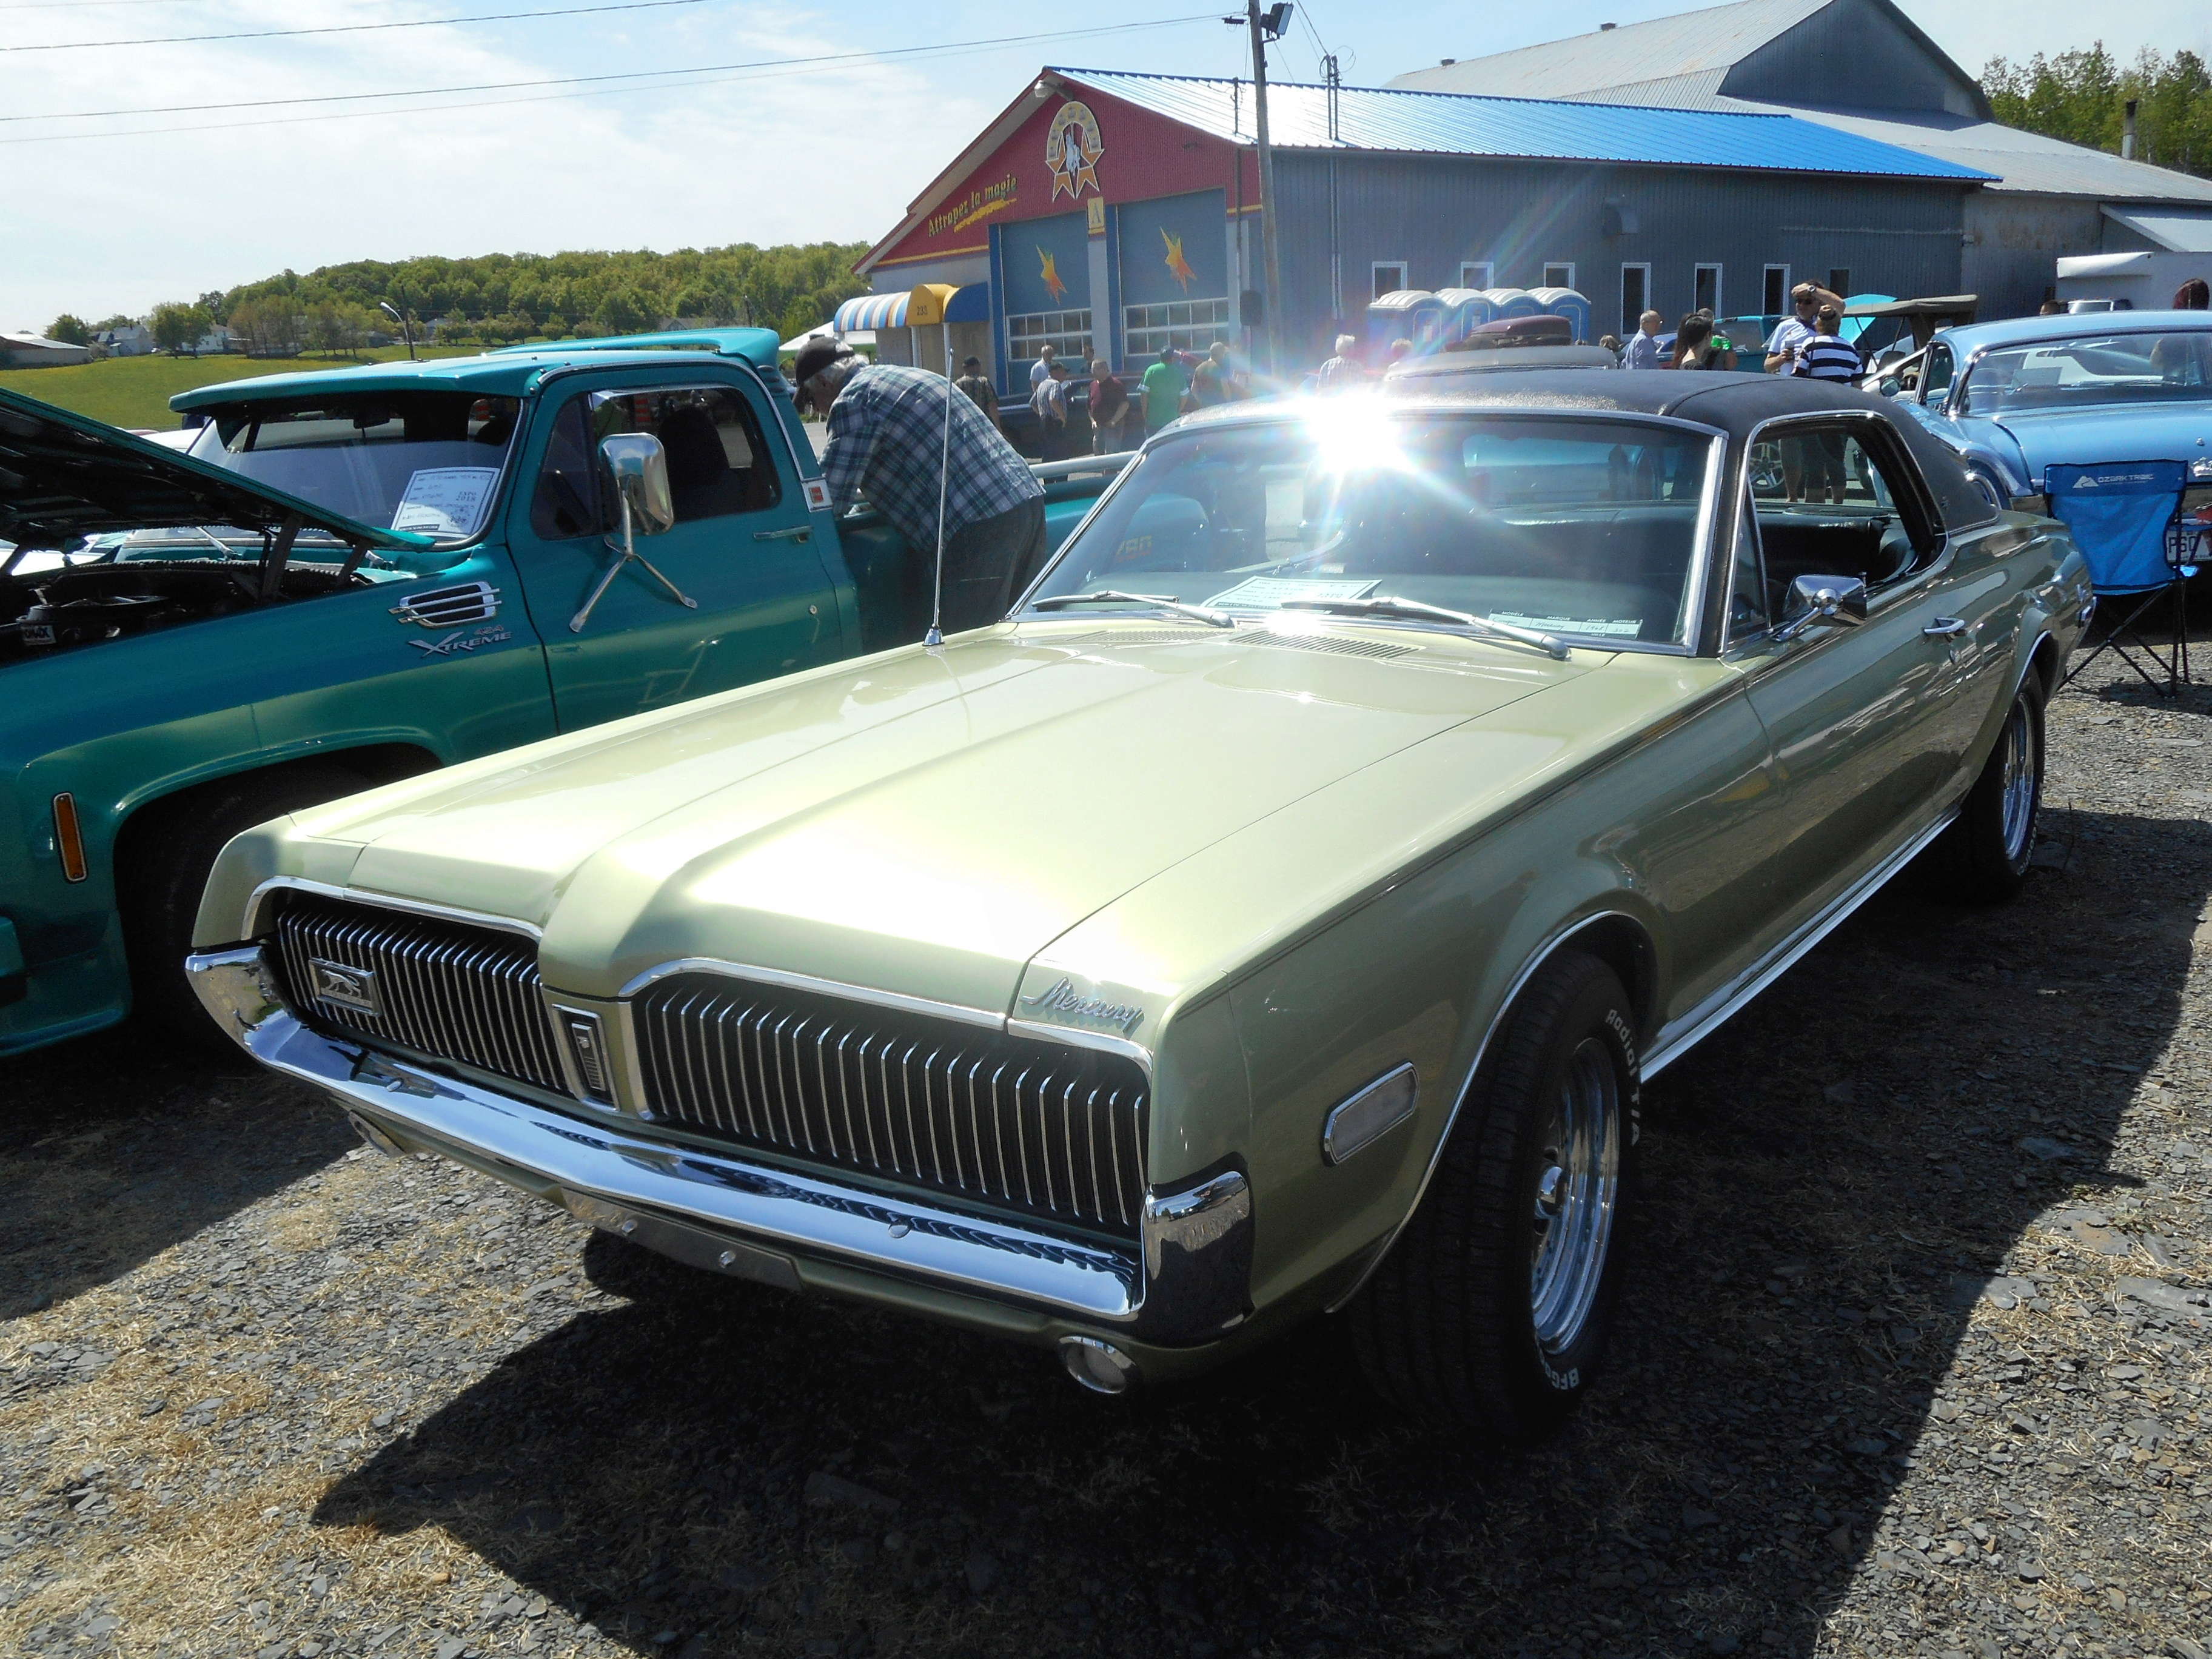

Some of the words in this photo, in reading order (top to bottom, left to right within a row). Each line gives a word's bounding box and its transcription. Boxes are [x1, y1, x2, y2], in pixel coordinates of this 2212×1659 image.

[928, 200, 969, 238] Attrapez
[971, 191, 981, 209] la
[985, 173, 1017, 199] magie
[407, 631, 513, 659] XTREME
[1020, 976, 1143, 1033] Mercury
[1606, 1008, 1638, 1076] Radial
